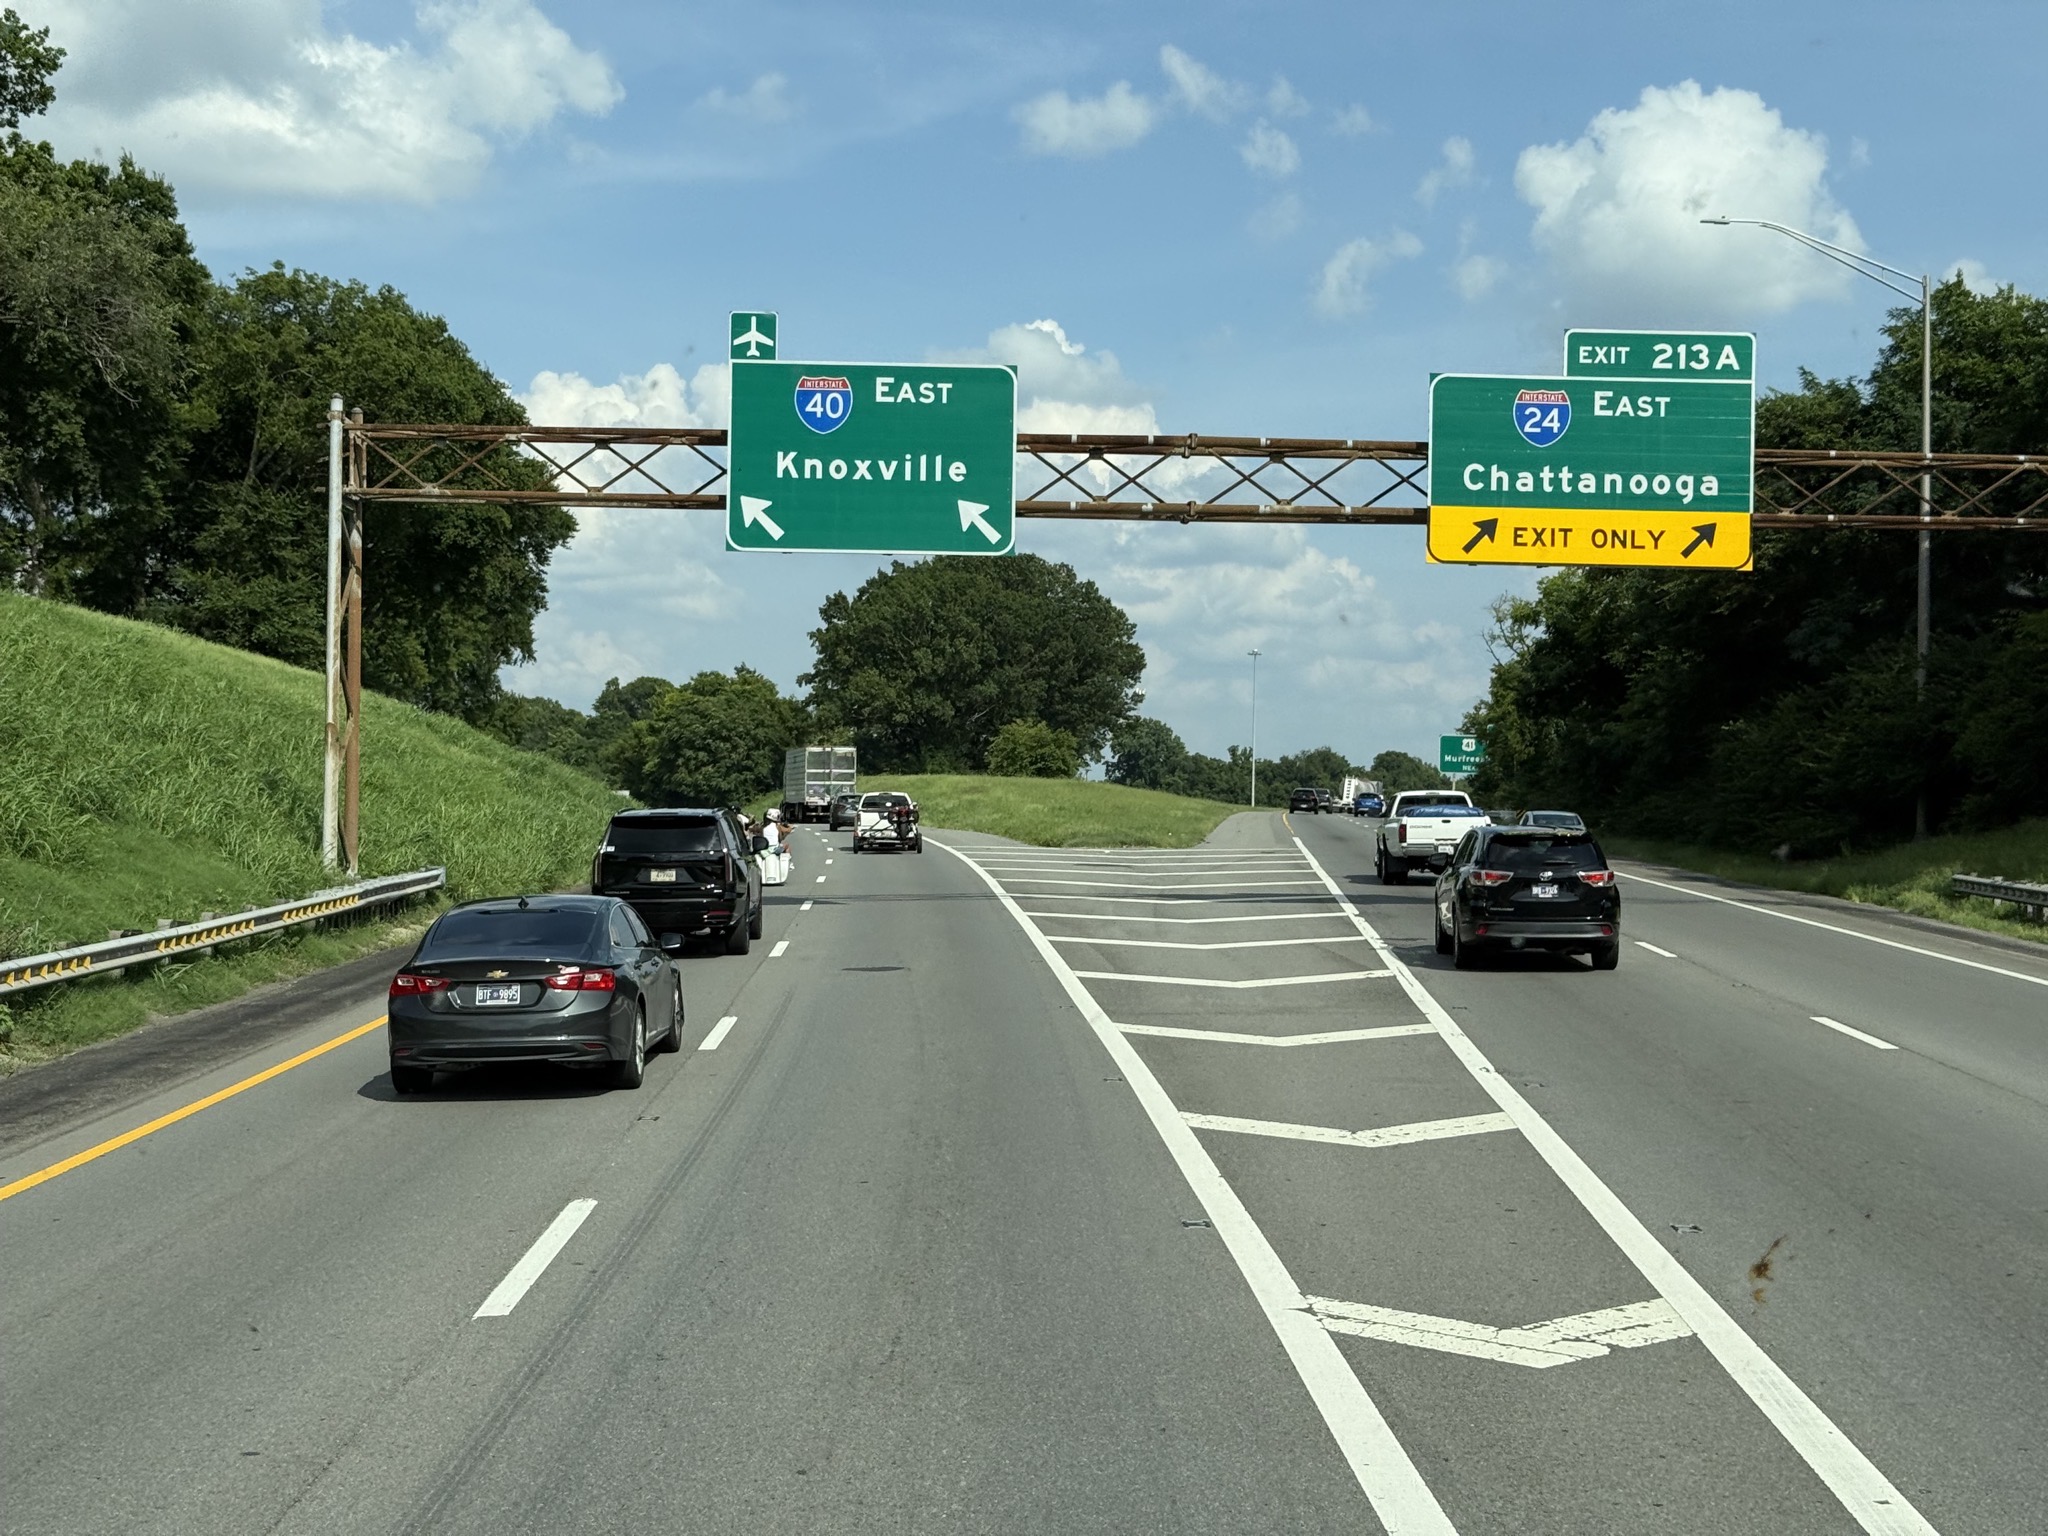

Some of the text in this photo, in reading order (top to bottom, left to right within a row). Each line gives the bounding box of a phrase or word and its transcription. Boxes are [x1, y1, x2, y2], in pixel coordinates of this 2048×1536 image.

[1579, 343, 1740, 371] EXIT 213A
[804, 380, 843, 389] INTERSTATE
[875, 377, 953, 404] EAST
[1522, 393, 1564, 402] INTERSTATE
[805, 392, 844, 419] 40
[1594, 390, 1671, 417] EAST
[1523, 407, 1561, 434] 24
[776, 451, 967, 482] Knoxville
[1463, 463, 1719, 504] Chattanooga
[1513, 527, 1667, 550] EXIT ONLY
[1465, 741, 1474, 749] 41
[478, 988, 518, 1000] BTF 9895
